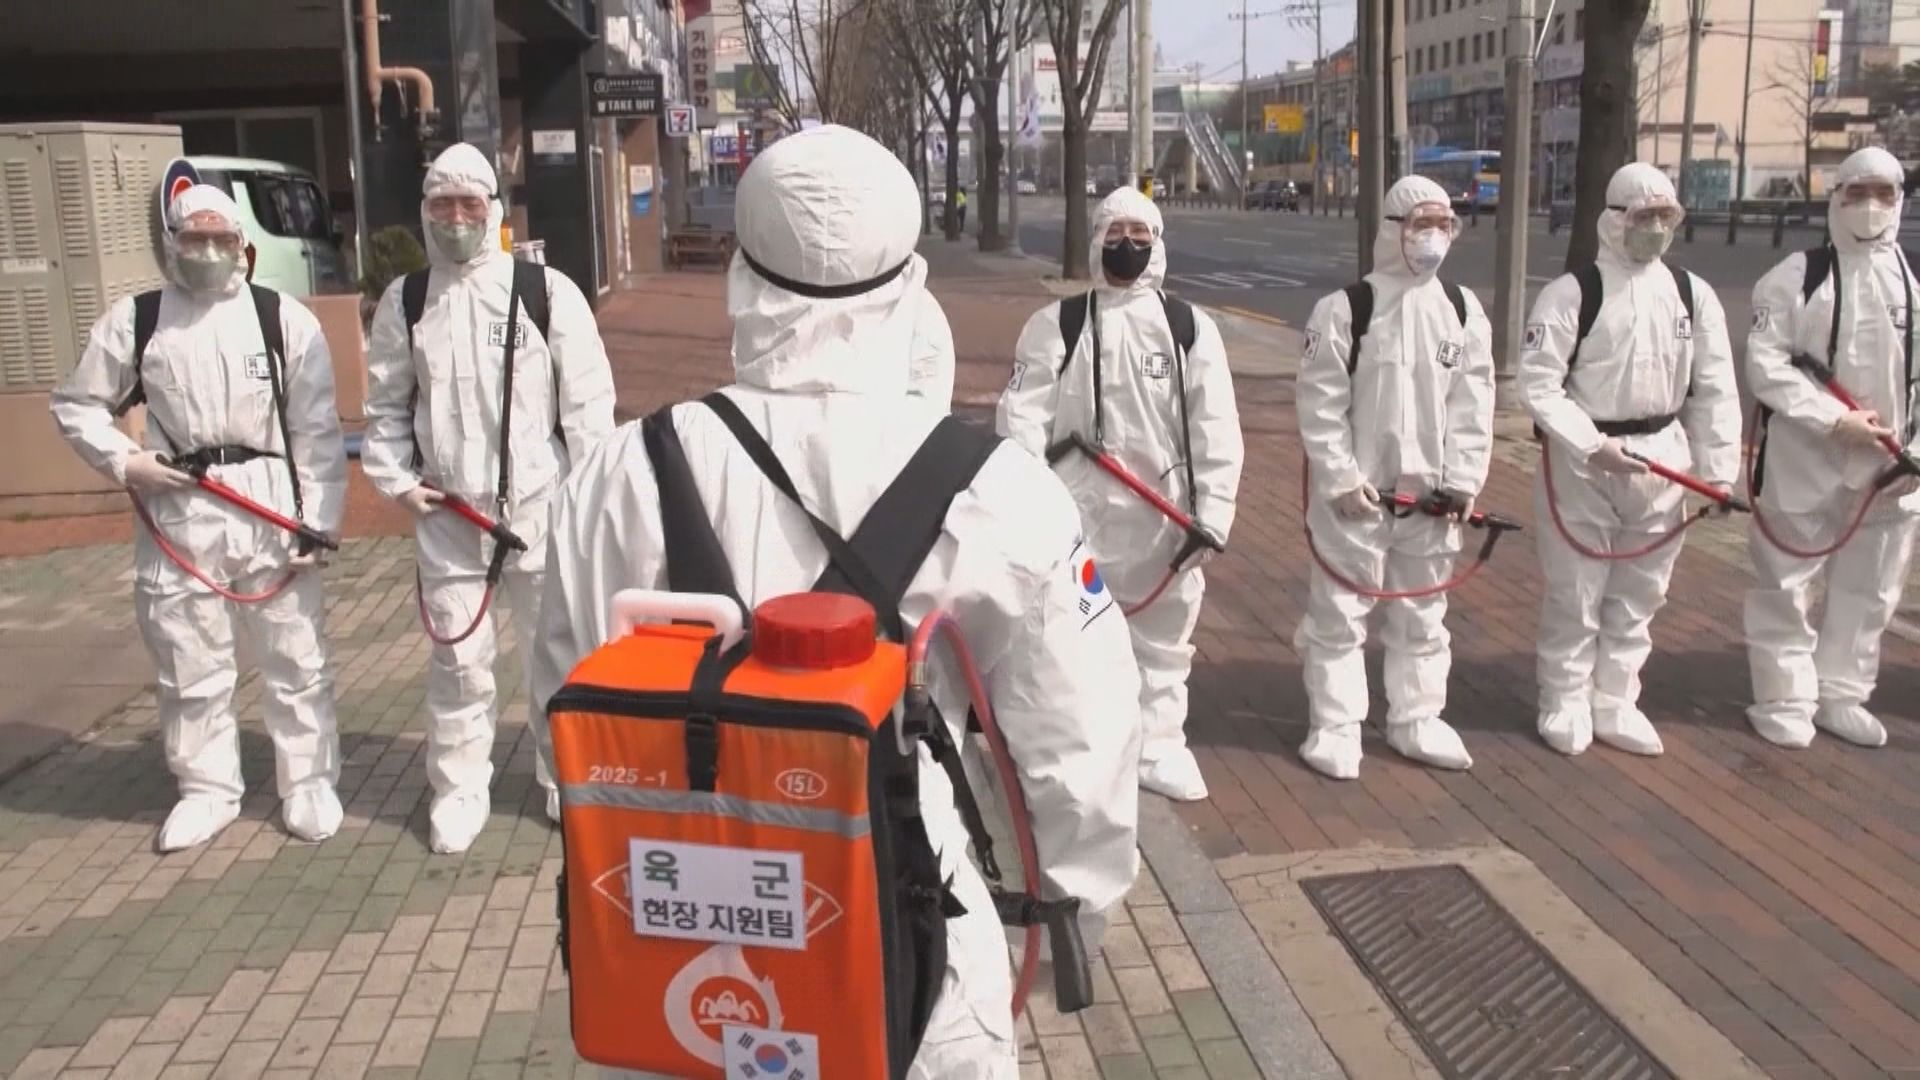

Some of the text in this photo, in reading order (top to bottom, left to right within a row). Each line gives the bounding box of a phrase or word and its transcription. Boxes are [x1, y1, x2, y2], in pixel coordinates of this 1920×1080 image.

[608, 98, 655, 112] TAKE OUT
[587, 765, 639, 784] 2025
[784, 774, 817, 794] 15L
[643, 849, 680, 891] 육
[752, 859, 789, 900] 군
[642, 898, 698, 930] 현장
[707, 903, 794, 939] 지원팀
